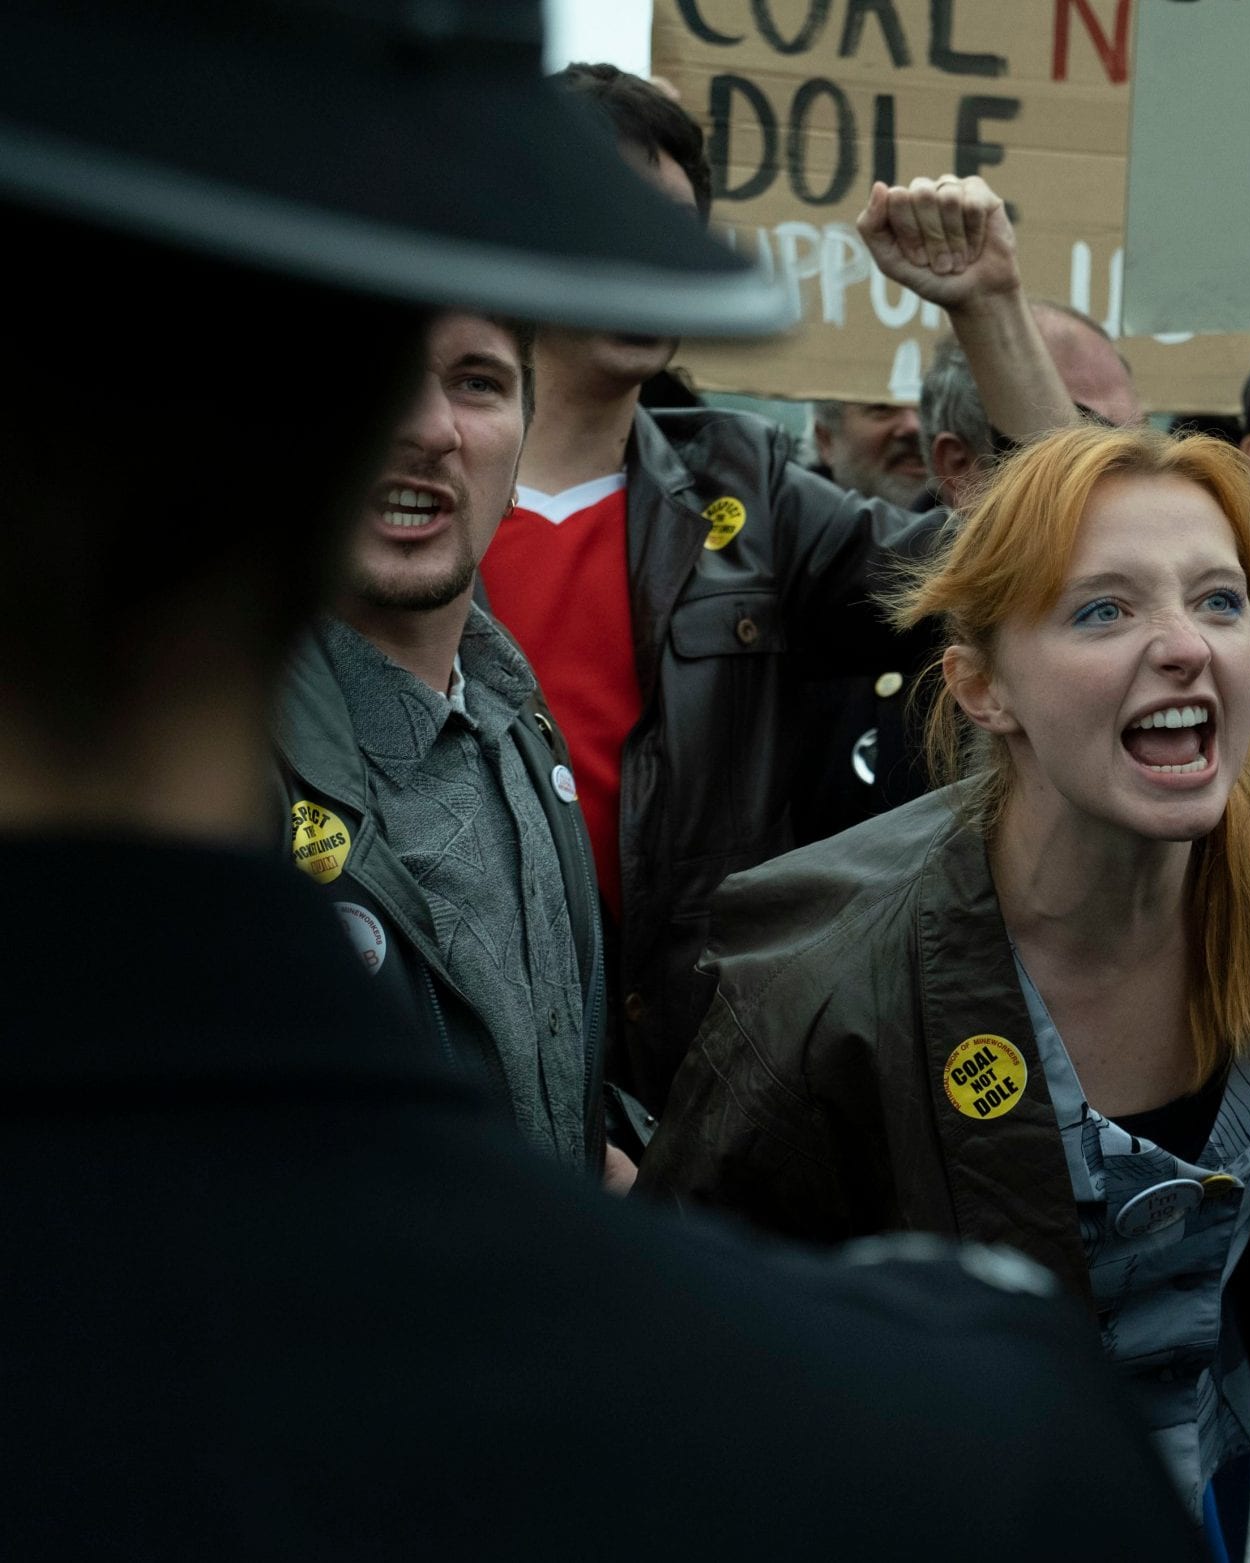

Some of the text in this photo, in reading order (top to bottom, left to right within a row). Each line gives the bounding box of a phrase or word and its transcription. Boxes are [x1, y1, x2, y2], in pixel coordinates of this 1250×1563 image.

[944, 1051, 961, 1074] UNION
[960, 1043, 971, 1053] OF
[974, 1038, 1020, 1067] MINEWORKERS
[951, 1045, 998, 1086] COAL
[970, 1068, 998, 1094] NOT
[973, 1076, 1019, 1118] DOLE
